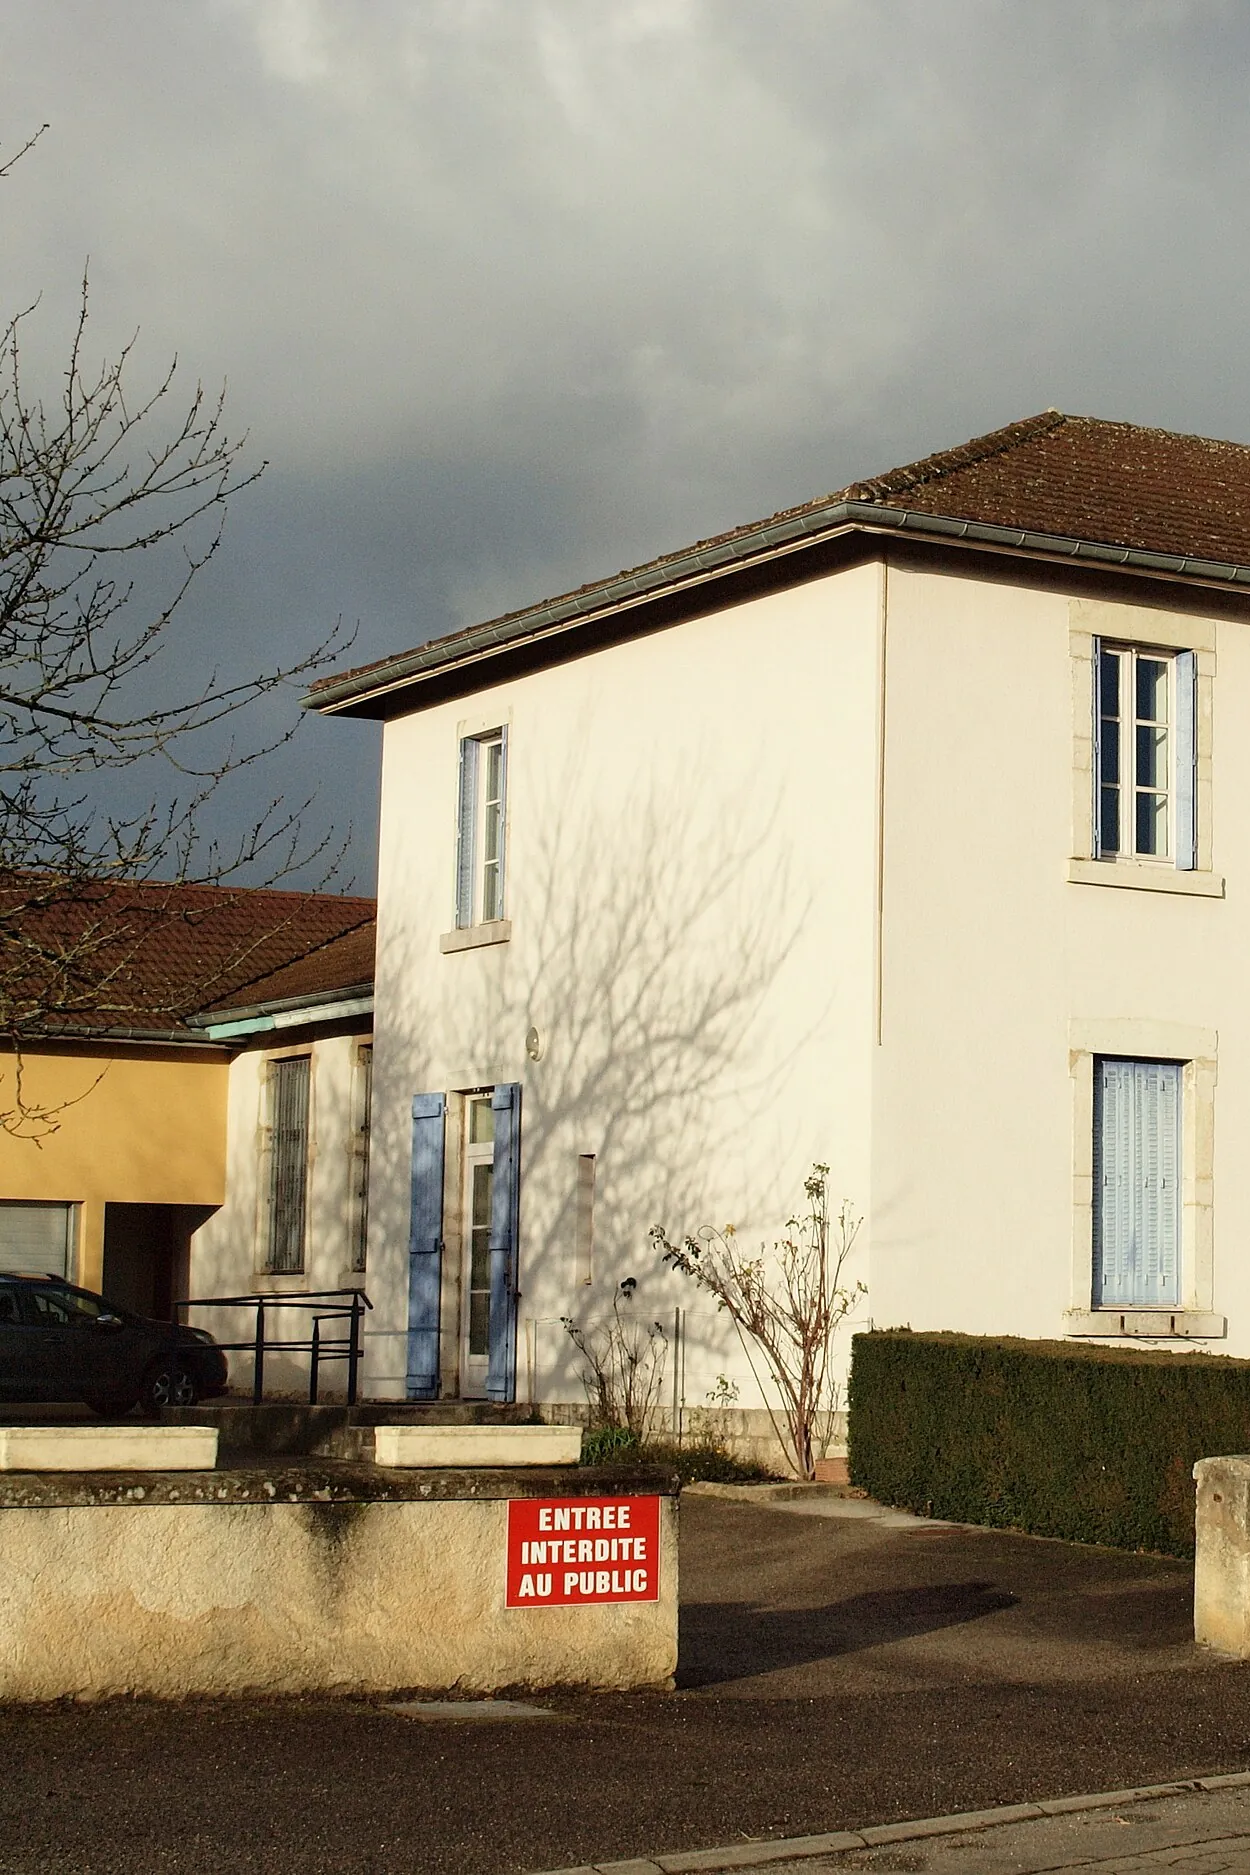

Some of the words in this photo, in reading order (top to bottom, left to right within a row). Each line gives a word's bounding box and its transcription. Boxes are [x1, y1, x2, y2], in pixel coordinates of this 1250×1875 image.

[538, 1506, 631, 1531] ENTREE
[521, 1537, 647, 1565] INTERDITE
[518, 1573, 552, 1597] AU
[563, 1568, 648, 1595] PUBLIC
